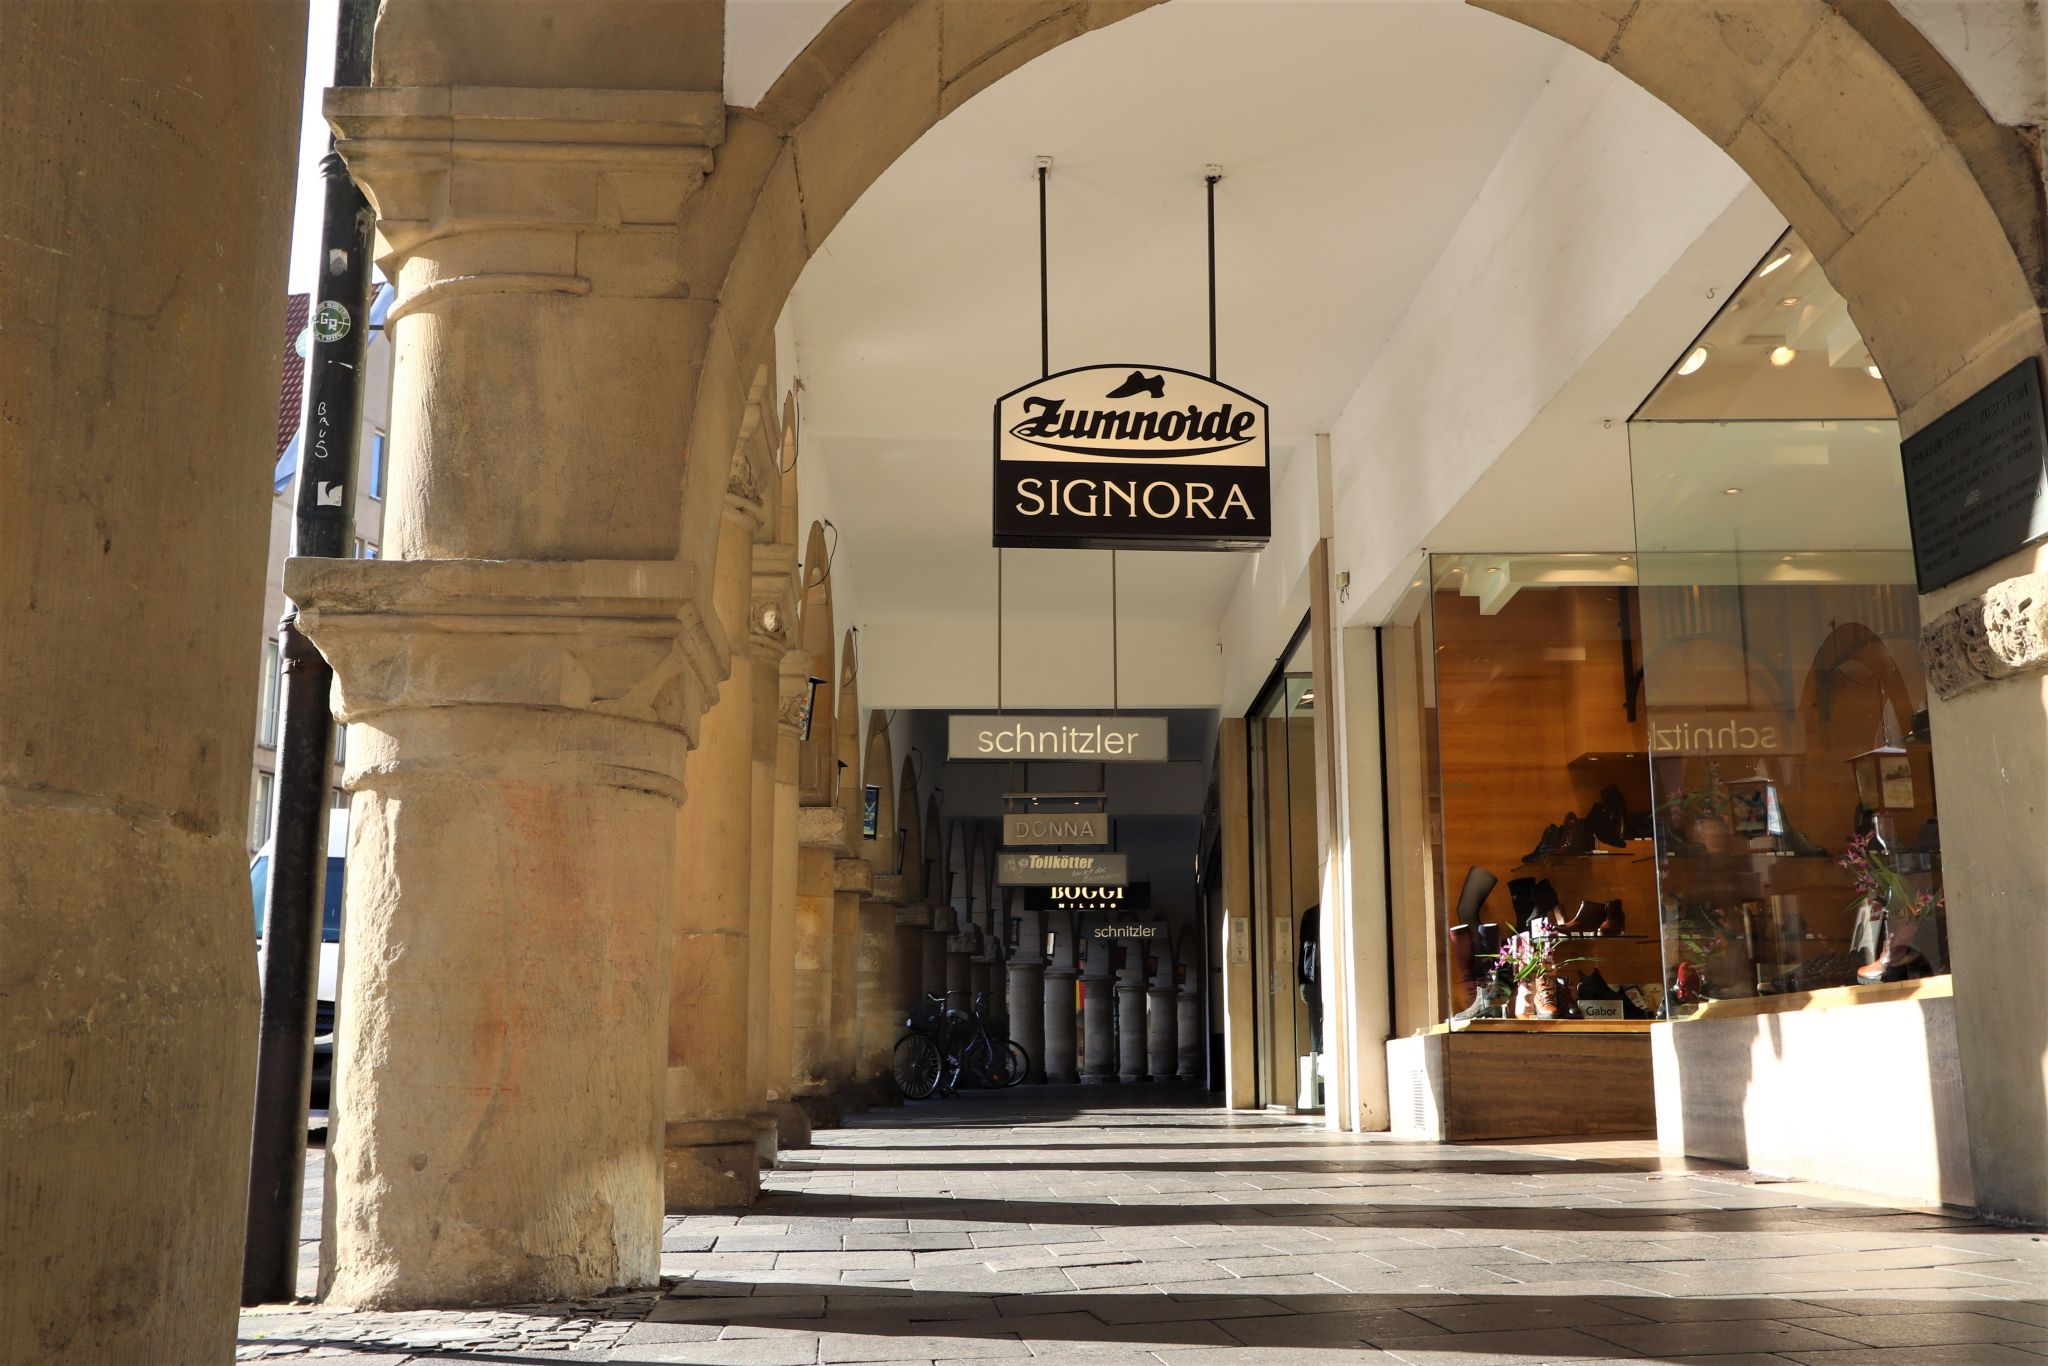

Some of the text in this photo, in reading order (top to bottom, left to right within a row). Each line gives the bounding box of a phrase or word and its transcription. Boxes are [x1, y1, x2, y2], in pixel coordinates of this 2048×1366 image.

[1010, 396, 1256, 444] Zumnorde
[1015, 478, 1256, 520] SIGNORA
[978, 723, 1140, 754] schnitzler
[1016, 820, 1095, 838] DONNA
[1029, 854, 1094, 869] Tollkötter
[1050, 886, 1125, 900] BOGGI
[1094, 924, 1157, 938] schnitzler
[1586, 1006, 1617, 1016] Gabor
